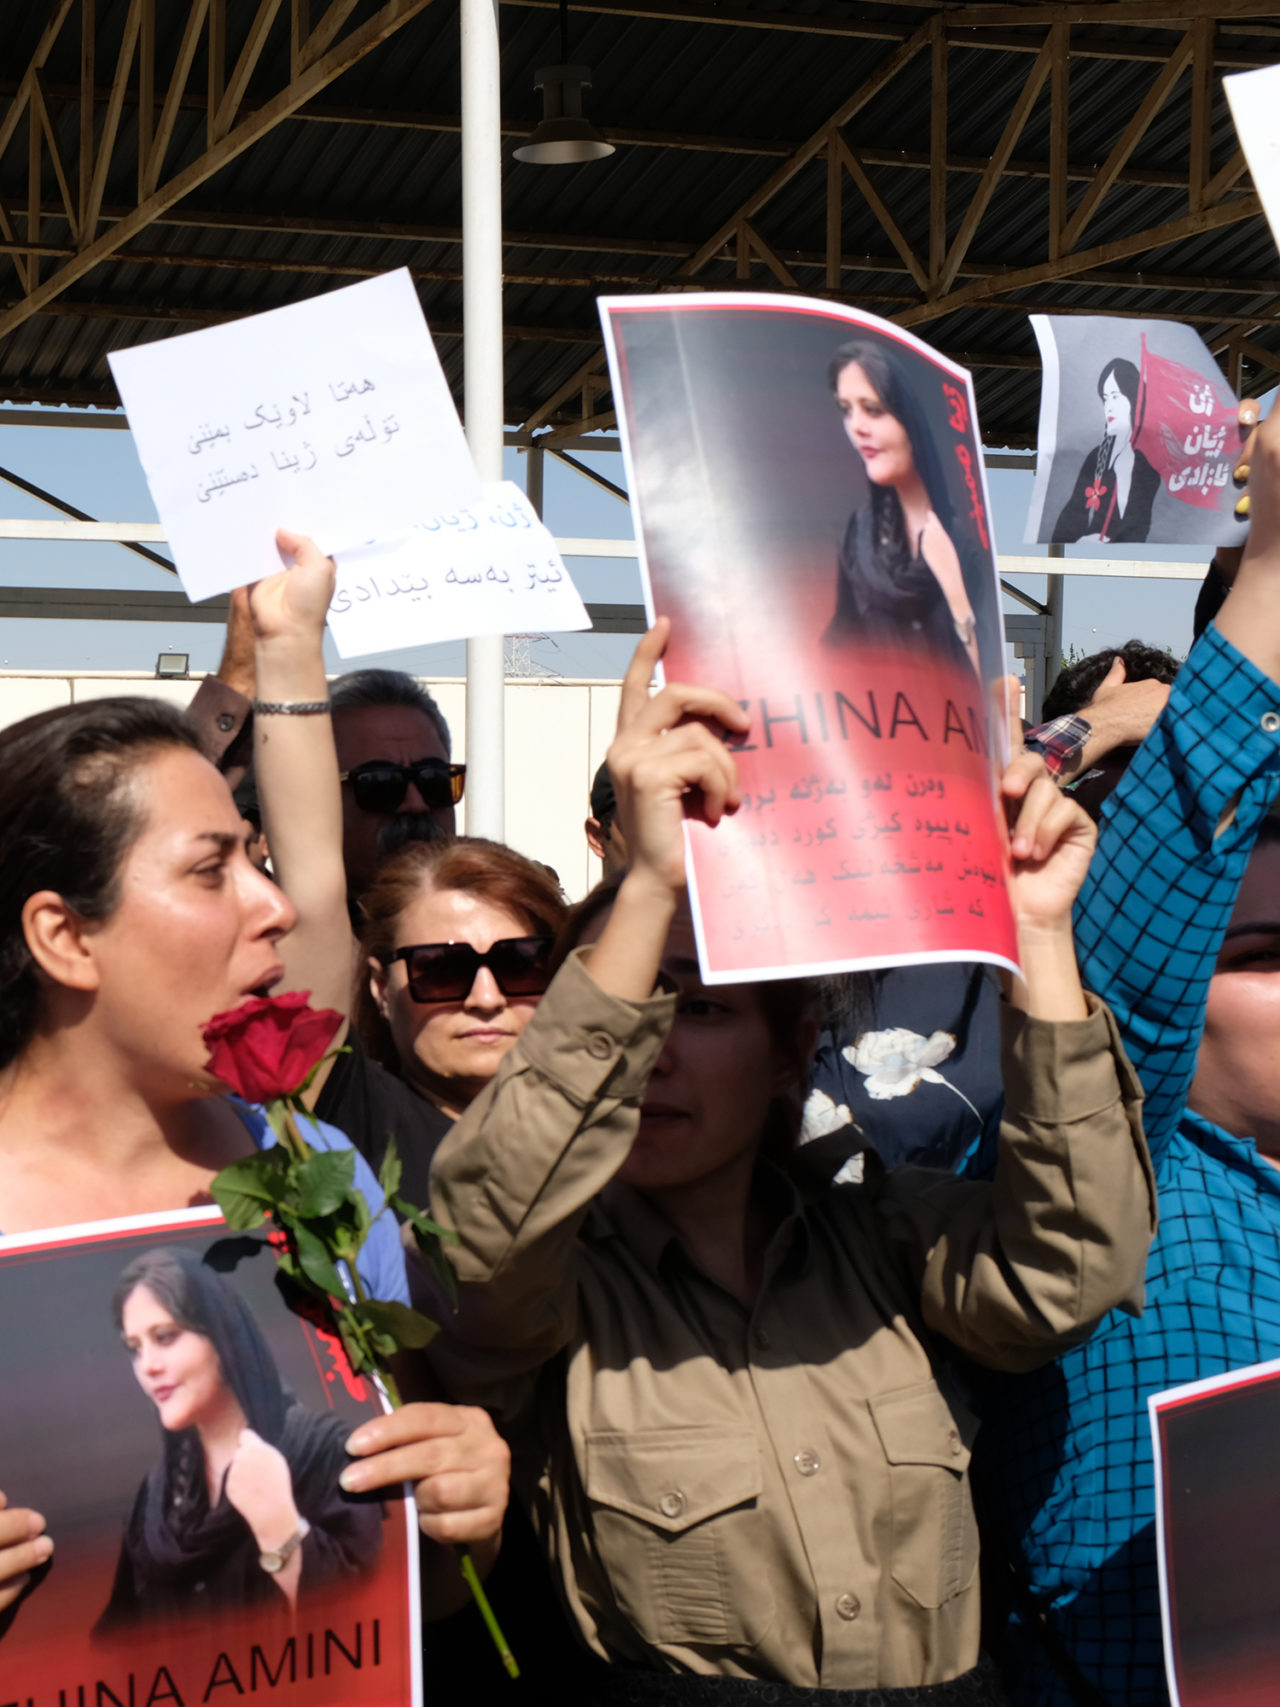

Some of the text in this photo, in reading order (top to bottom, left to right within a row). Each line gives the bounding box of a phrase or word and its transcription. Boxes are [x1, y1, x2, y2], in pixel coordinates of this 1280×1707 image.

[1189, 384, 1214, 417] ژن
[271, 440, 318, 473] ژینا
[1183, 424, 1227, 458] ژیان
[202, 1618, 381, 1703] AMINI
